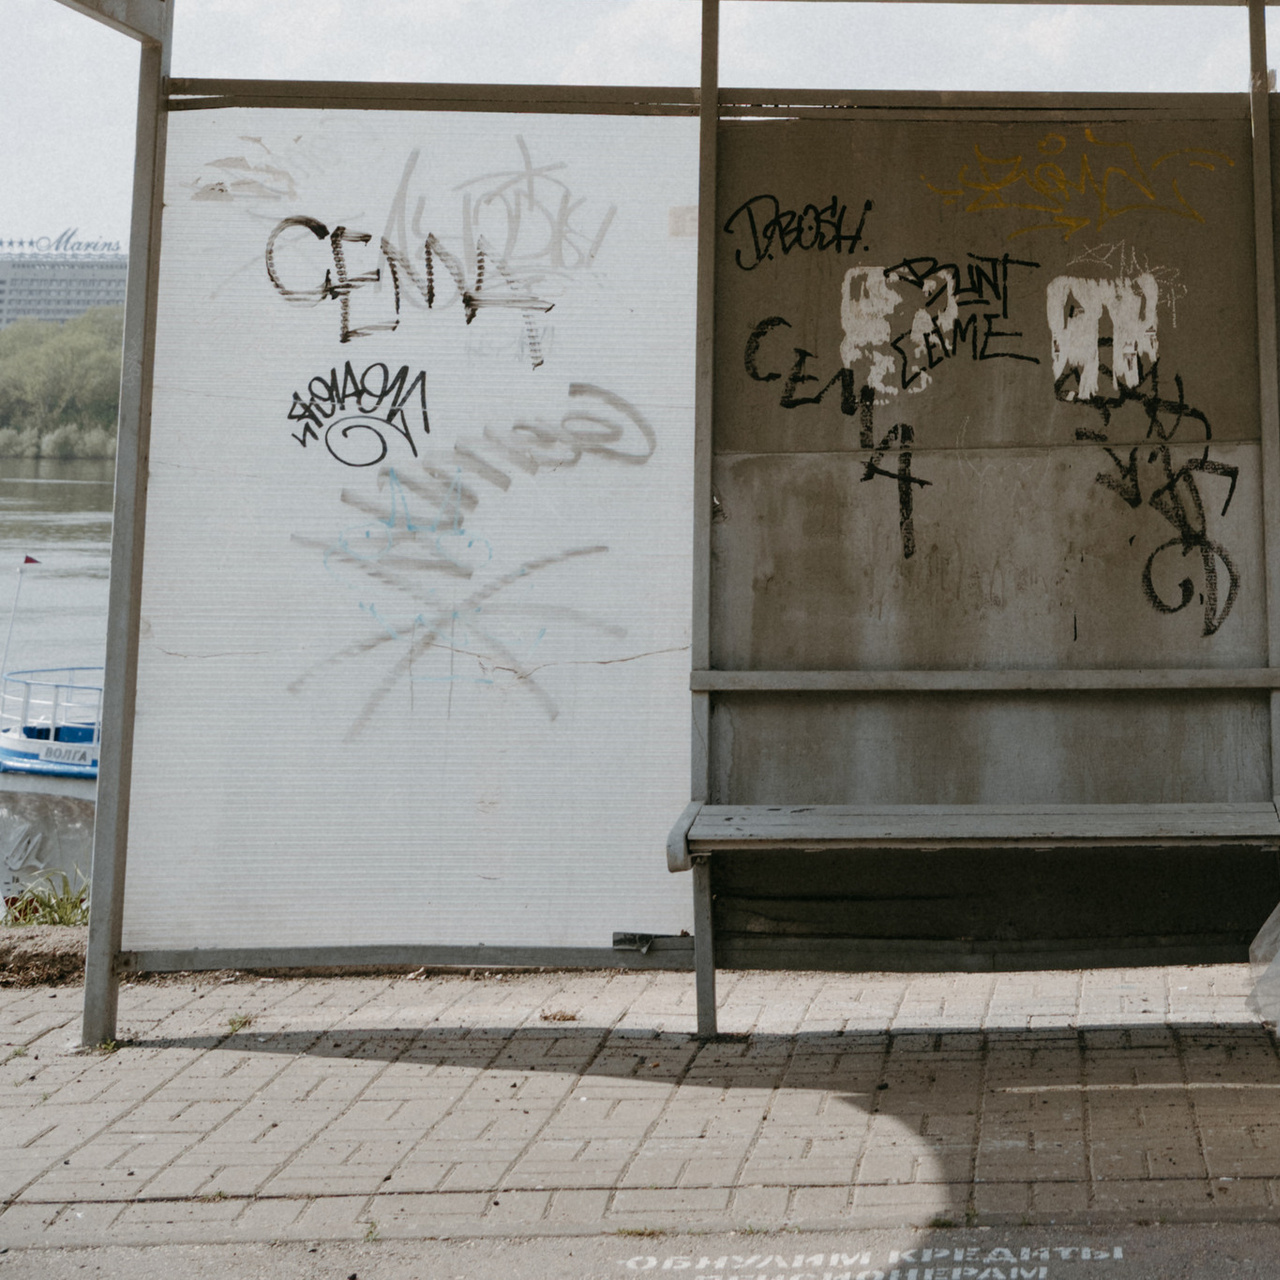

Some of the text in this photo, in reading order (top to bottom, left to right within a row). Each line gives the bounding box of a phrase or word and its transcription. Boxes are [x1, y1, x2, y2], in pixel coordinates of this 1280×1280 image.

[36, 227, 121, 252] Marins
[44, 746, 87, 762] ВОЛГА
[888, 1246, 1123, 1264] КРЕДИТЫ
